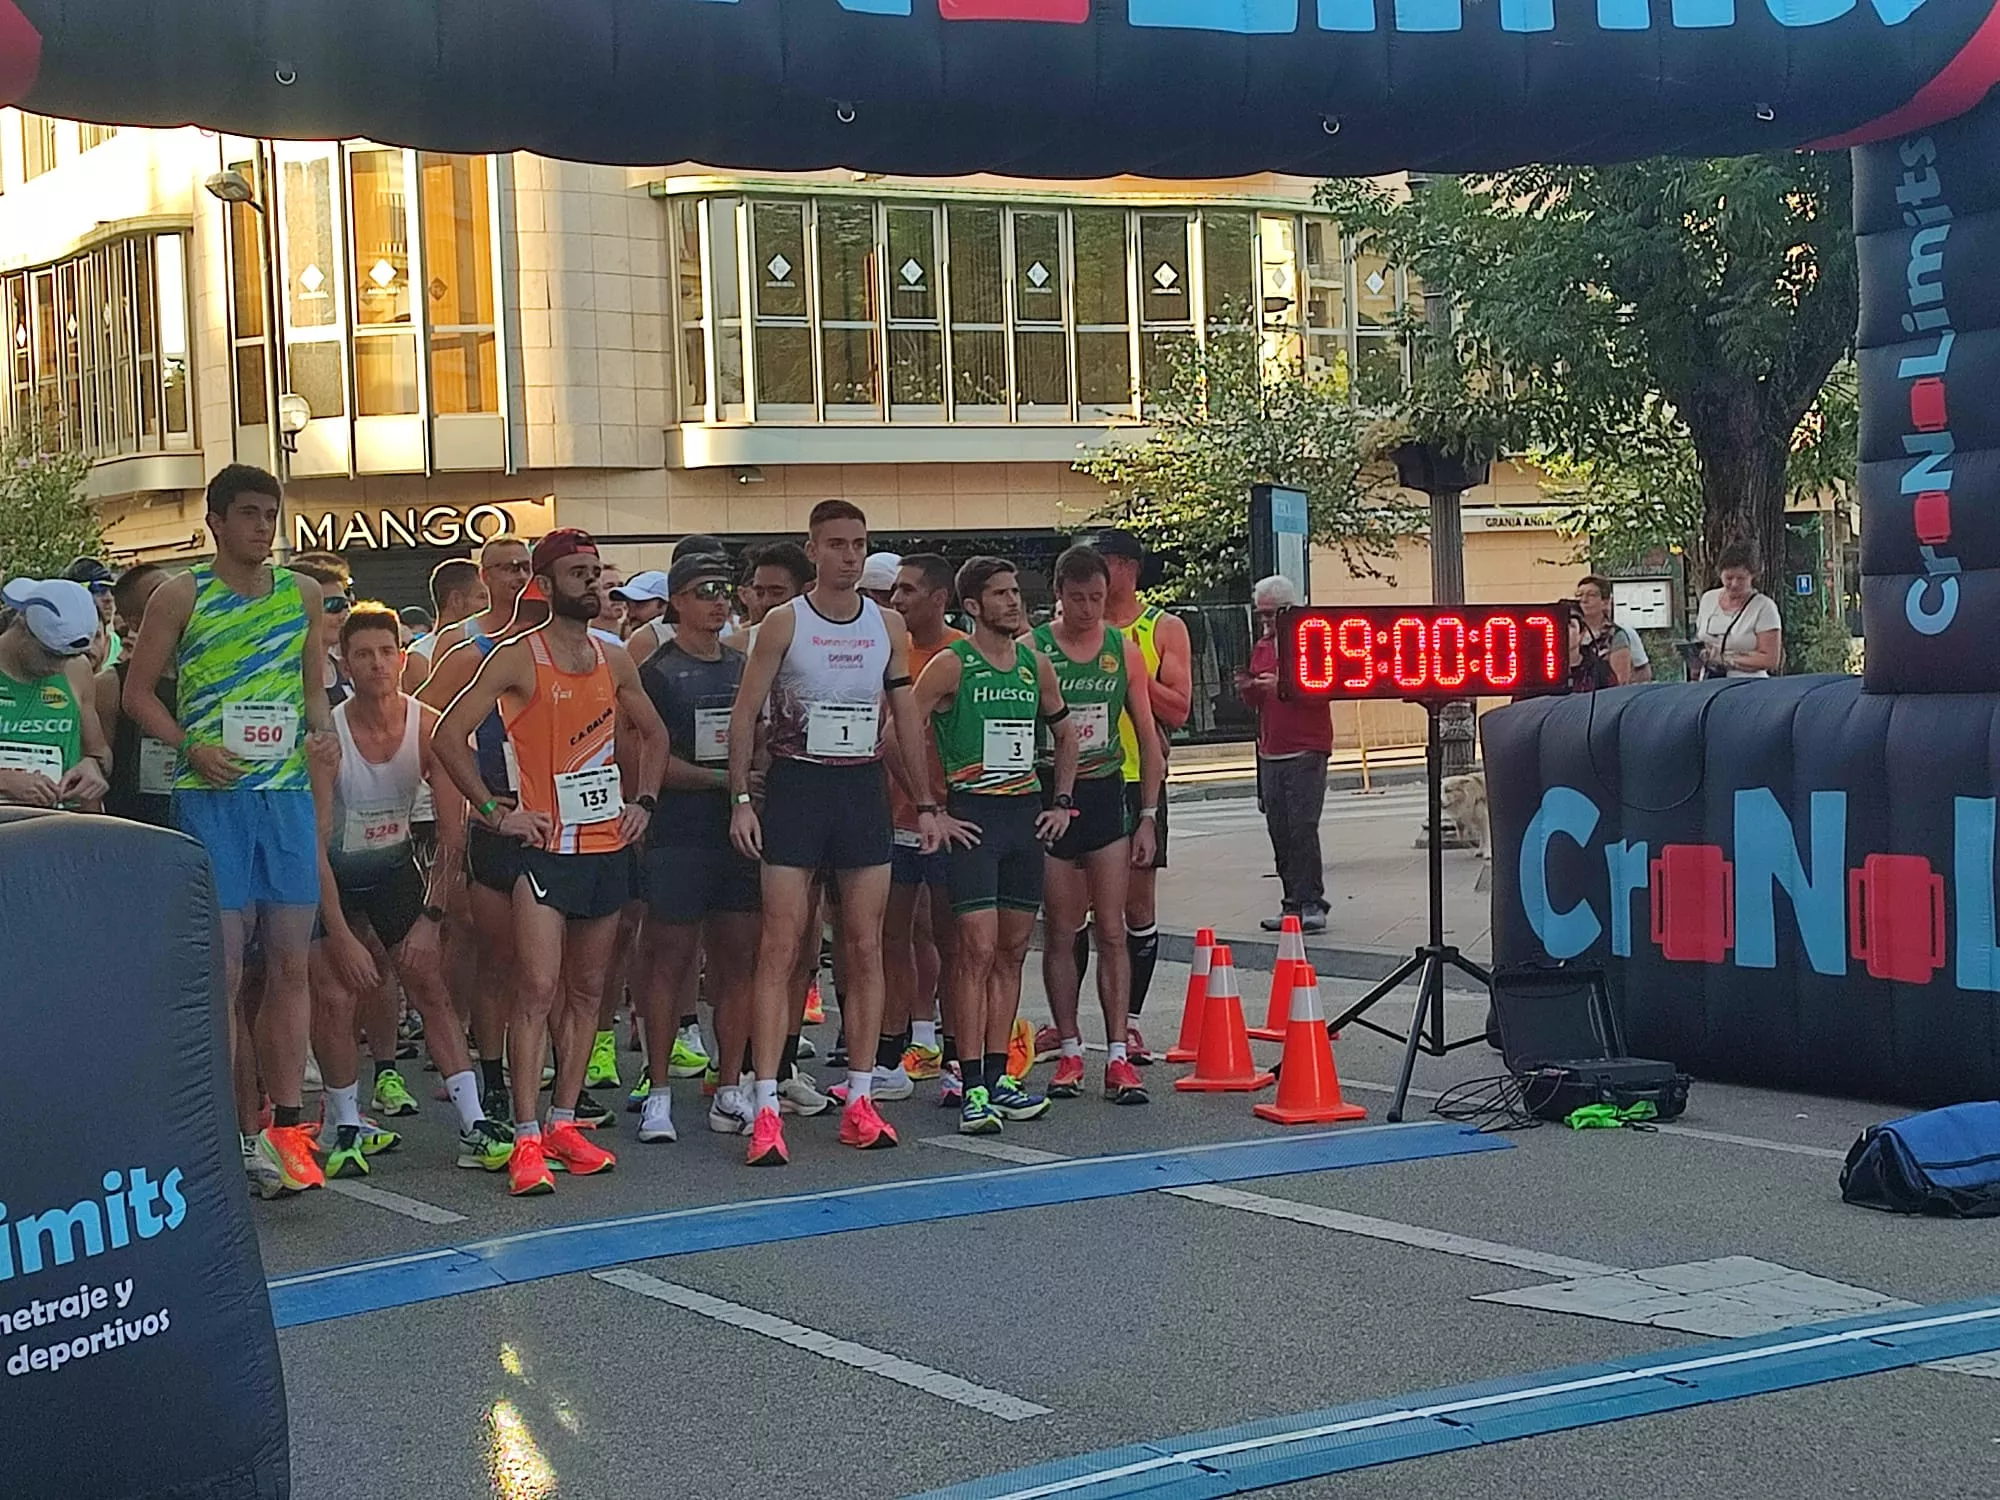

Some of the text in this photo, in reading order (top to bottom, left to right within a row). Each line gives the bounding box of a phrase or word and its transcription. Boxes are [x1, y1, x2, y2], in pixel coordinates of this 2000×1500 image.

[294, 503, 508, 552] MANGO
[1298, 616, 1555, 688] 09:00:07
[1057, 676, 1117, 691] uesca
[973, 686, 1035, 703] Huesca
[0, 714, 73, 734] uesca
[243, 725, 283, 743] 560
[840, 725, 850, 741] 1
[1013, 742, 1022, 757] 3
[578, 788, 608, 808] 133
[114, 1278, 134, 1309] y
[6, 1308, 171, 1376] deportivos
